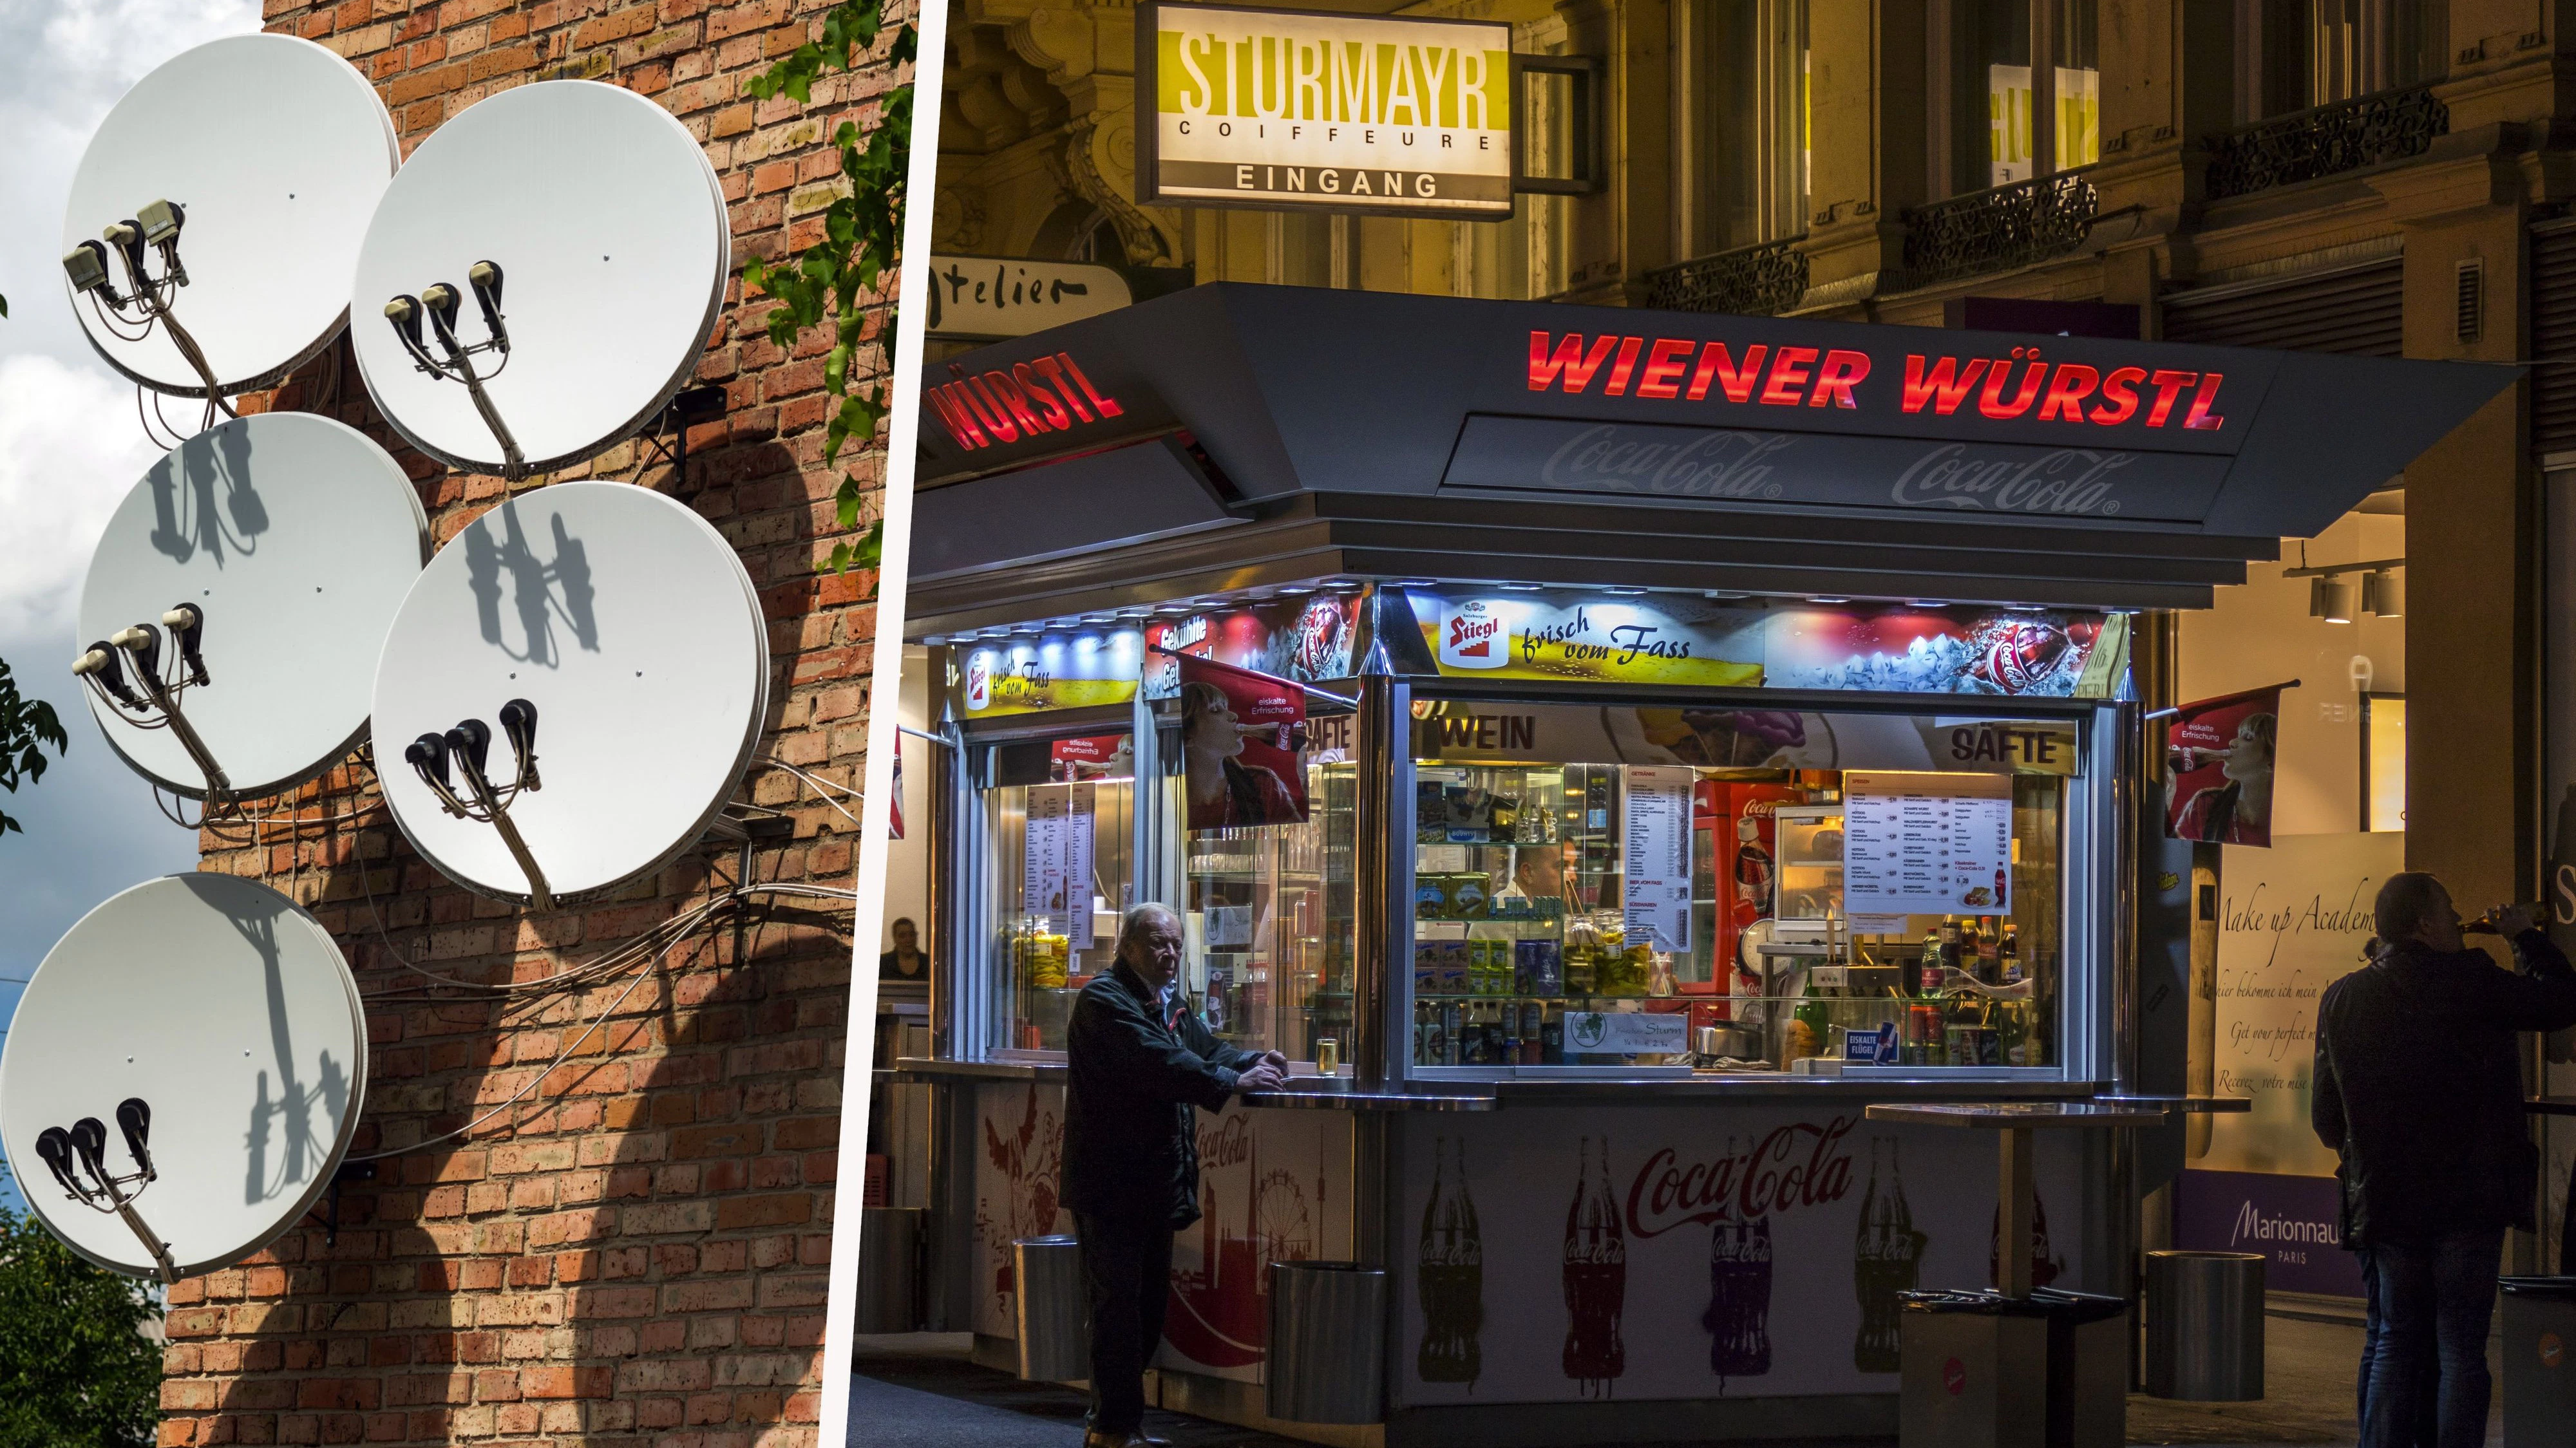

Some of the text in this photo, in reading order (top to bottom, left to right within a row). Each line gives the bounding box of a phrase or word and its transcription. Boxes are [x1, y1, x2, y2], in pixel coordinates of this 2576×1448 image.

[1178, 30, 1487, 131] STURMAYR
[1179, 120, 1489, 150] COIFFEURE
[1236, 165, 1437, 198] EINGANG
[1528, 331, 2224, 430] WIENER WÜRSTL
[922, 352, 1123, 451] WÜRSTL
[1161, 616, 1207, 655] Gekühlte
[1450, 616, 1498, 648] Stiegl
[1522, 606, 1589, 664] frisch
[1565, 625, 1690, 665] vom Fass
[970, 666, 985, 693] Stiegl
[993, 648, 1013, 702] frisch
[1007, 661, 1049, 697] vom Fass
[1258, 697, 1287, 706] eiskalte
[1437, 715, 1535, 750] WEIN
[2182, 731, 2219, 742] Erfrischung
[2188, 724, 2214, 732] eiskalte
[2266, 905, 2294, 967] up
[2297, 877, 2377, 935] Academ
[2237, 971, 2276, 997] bekomme
[2278, 969, 2301, 998] ich
[1850, 1035, 1877, 1044] EISKALTE
[1852, 1044, 1874, 1054] FLÜGEL
[2231, 1021, 2251, 1048] Get
[2244, 1030, 2273, 1055] your
[2269, 1011, 2307, 1062] perfect
[2219, 1070, 2307, 1093] Recevez votre mise
[2231, 1200, 2339, 1247] Marionnau
[2278, 1250, 2306, 1265] PARIS
